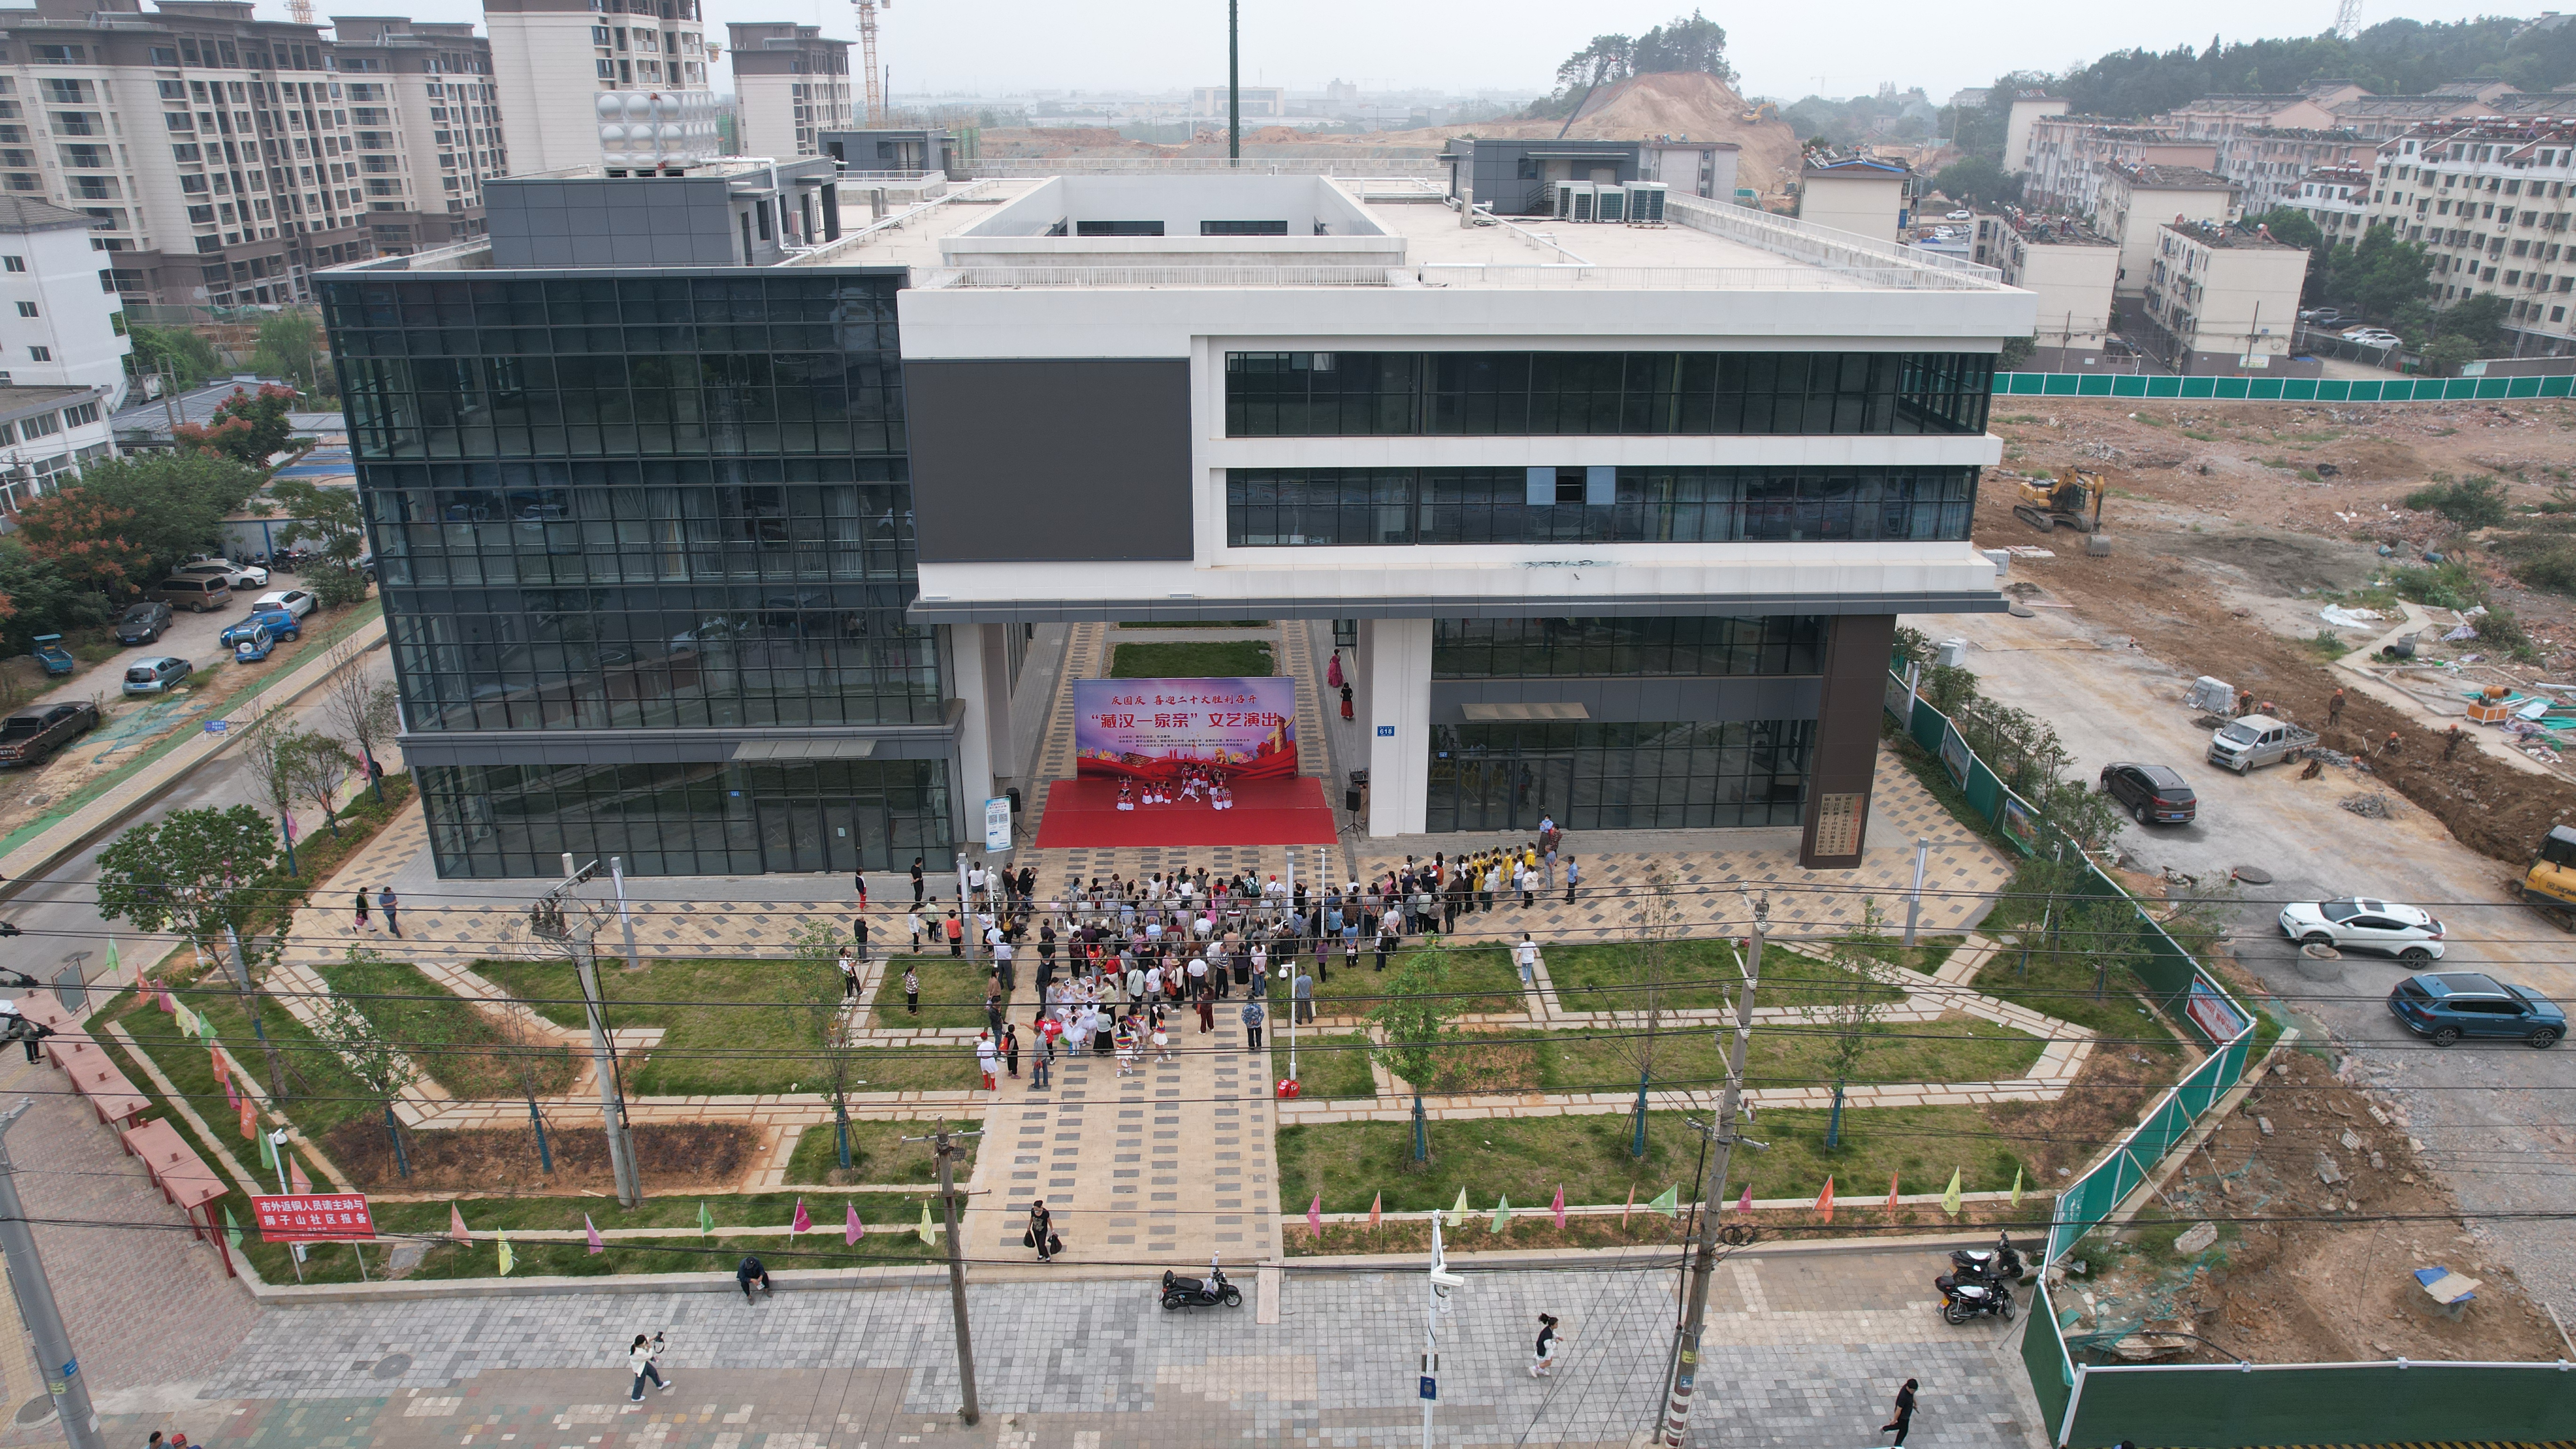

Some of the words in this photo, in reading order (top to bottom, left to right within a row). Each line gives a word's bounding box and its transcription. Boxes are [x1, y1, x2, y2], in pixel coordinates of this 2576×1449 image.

[1111, 695, 1146, 706] 庆国庆
[1153, 695, 1257, 705] 喜迎二十大胜利召开
[1092, 713, 1198, 728] “藏汉一家亲”
[1208, 712, 1279, 728] 文艺演出
[1828, 797, 1841, 853] 铜官区狮子山社区服务中心
[1838, 797, 1852, 853] 铜官区狮子山社区居民委员会
[260, 1199, 363, 1213] 市外返铜人员请主动与
[264, 1213, 367, 1226] 狮子山社区报备
